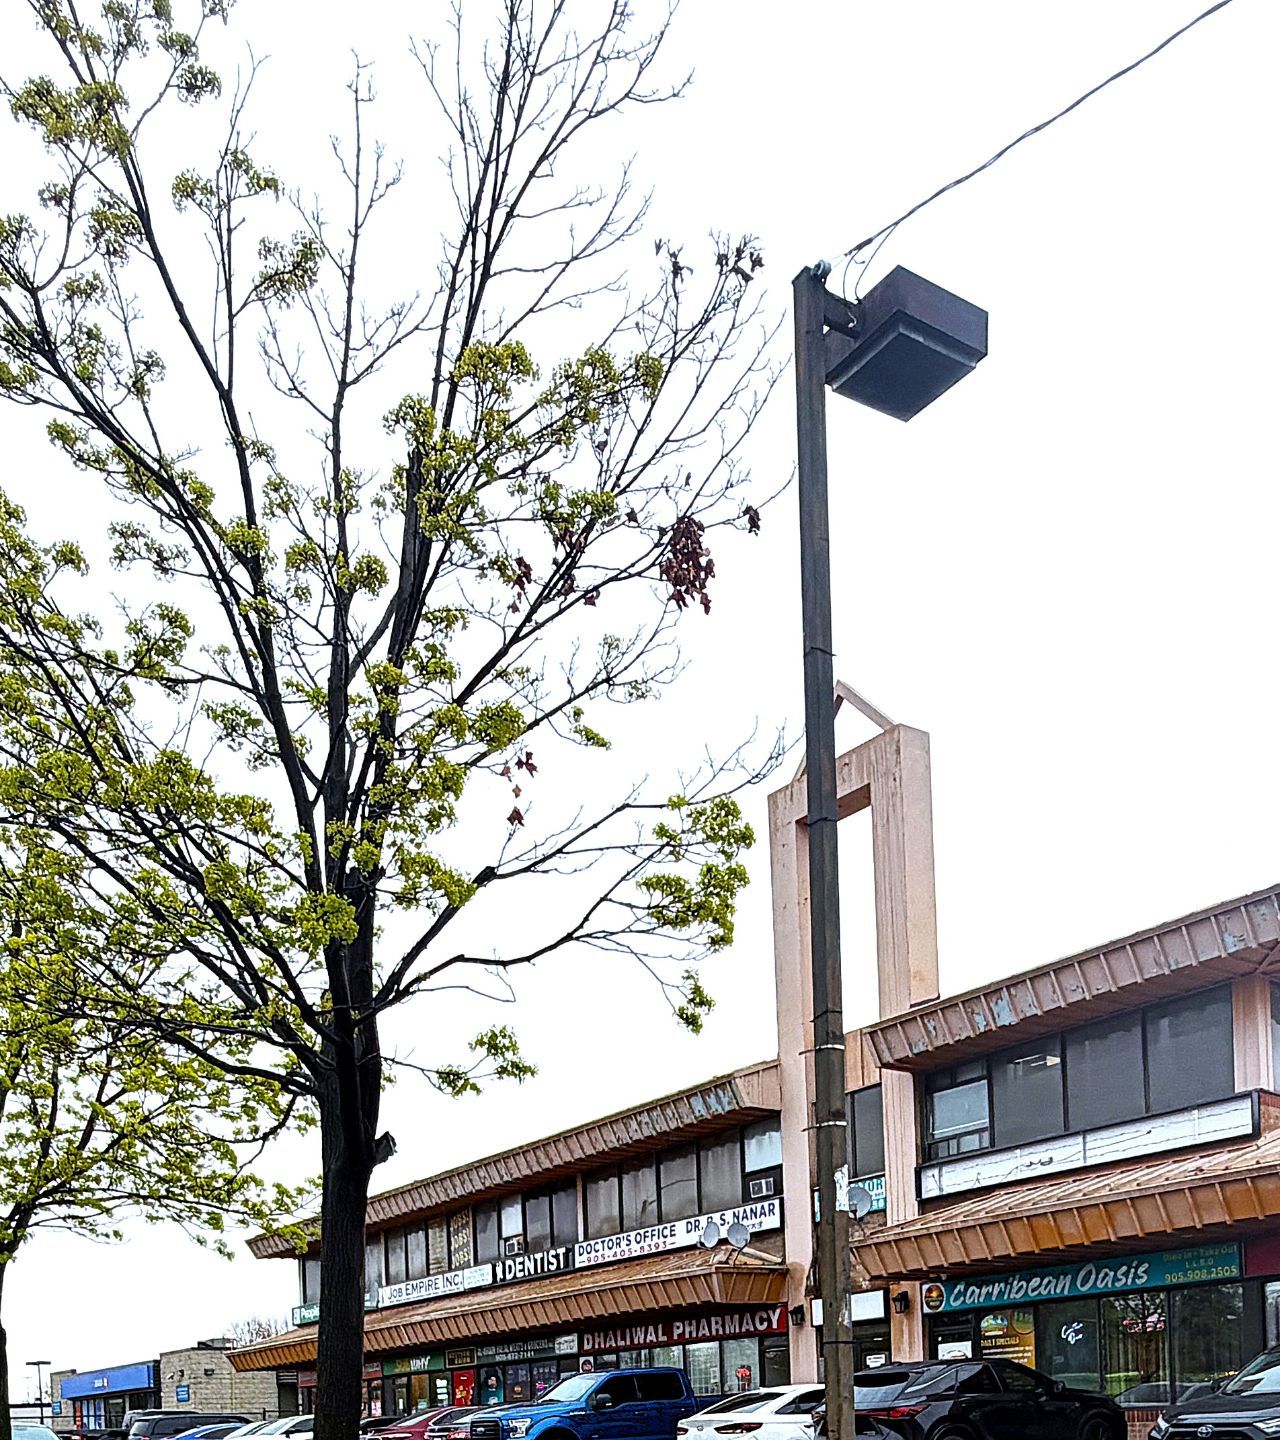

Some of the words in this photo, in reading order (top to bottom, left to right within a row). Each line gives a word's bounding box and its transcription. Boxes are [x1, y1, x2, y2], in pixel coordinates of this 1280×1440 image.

[578, 1233, 632, 1257] DOCTOR'S
[634, 1224, 677, 1245] OFFICE
[686, 1220, 704, 1234] DR.
[733, 1202, 776, 1223] NANAR
[405, 1277, 440, 1296] EMPIRE
[442, 1273, 463, 1289] INC.
[505, 1247, 567, 1279] DENTIST
[950, 1274, 1072, 1308] Carribean
[1076, 1260, 1150, 1292] Oasis
[582, 1323, 668, 1351] DHALIWAL
[672, 1306, 782, 1340] PHARMACY
